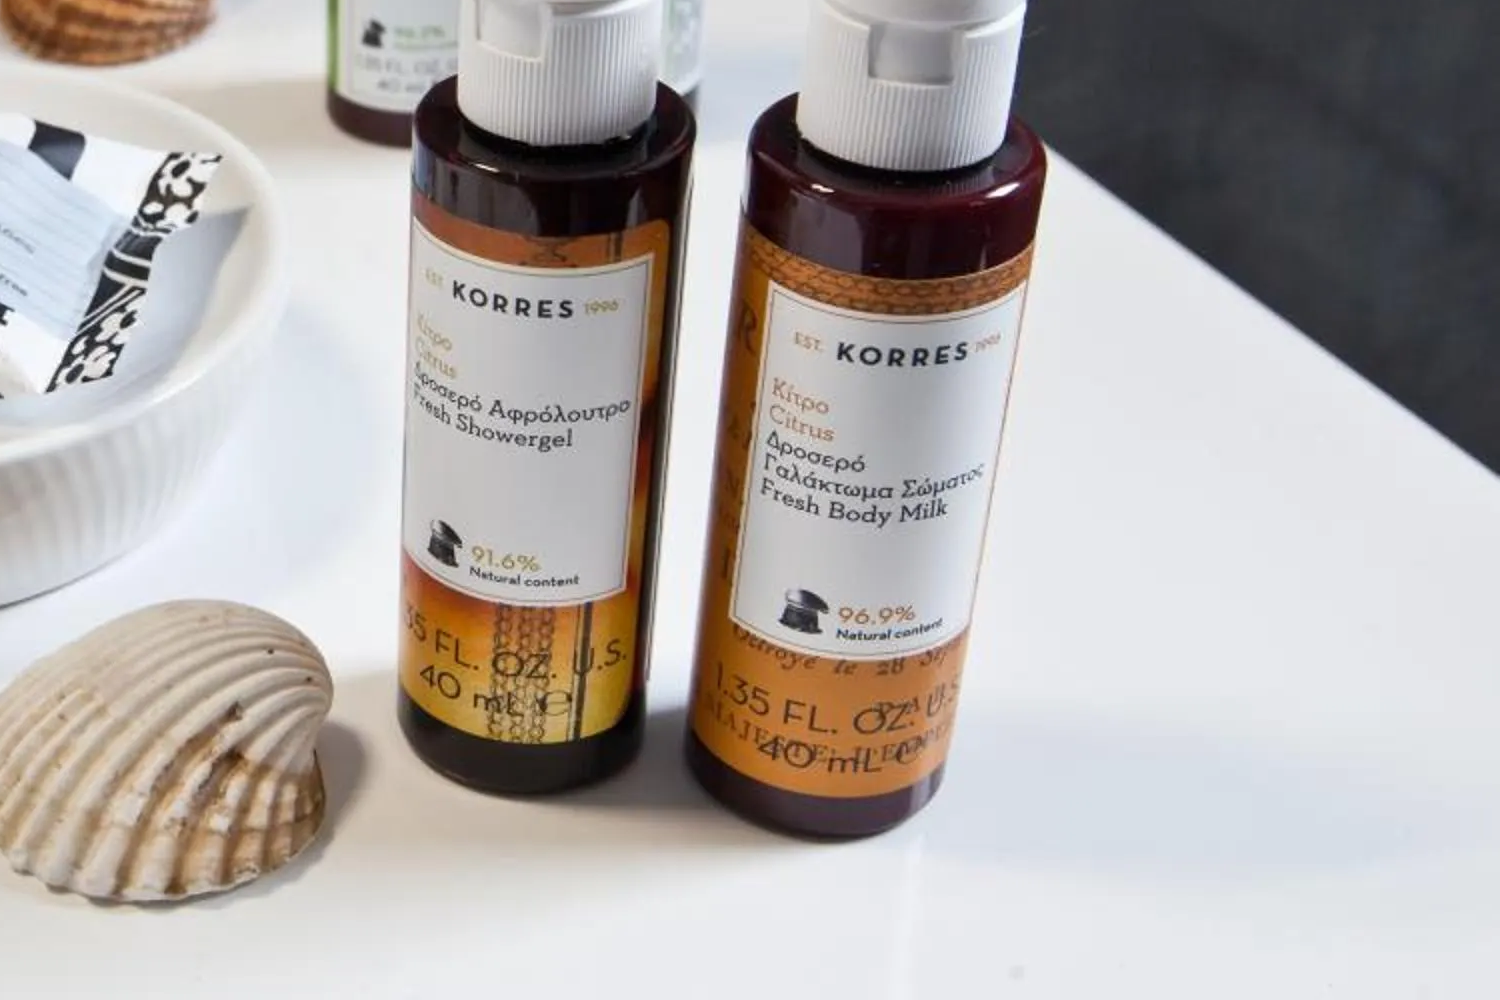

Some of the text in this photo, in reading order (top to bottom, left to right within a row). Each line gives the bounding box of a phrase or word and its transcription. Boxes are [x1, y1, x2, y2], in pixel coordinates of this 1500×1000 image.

[452, 279, 575, 319] KORRES
[836, 341, 969, 368] KORRES
[412, 382, 574, 453] Fresh Showergel
[768, 403, 836, 443] Citrus
[760, 476, 821, 517] Fresh
[828, 499, 893, 530] Body
[898, 499, 949, 524] Milk
[471, 545, 542, 572] 91.6%
[468, 566, 581, 588] Natural content
[835, 617, 944, 642] Natural content
[837, 604, 917, 626] 96.9%
[419, 664, 462, 700] 40
[715, 661, 771, 716] 1.35
[782, 698, 838, 735] FL.
[757, 737, 816, 769] 40
